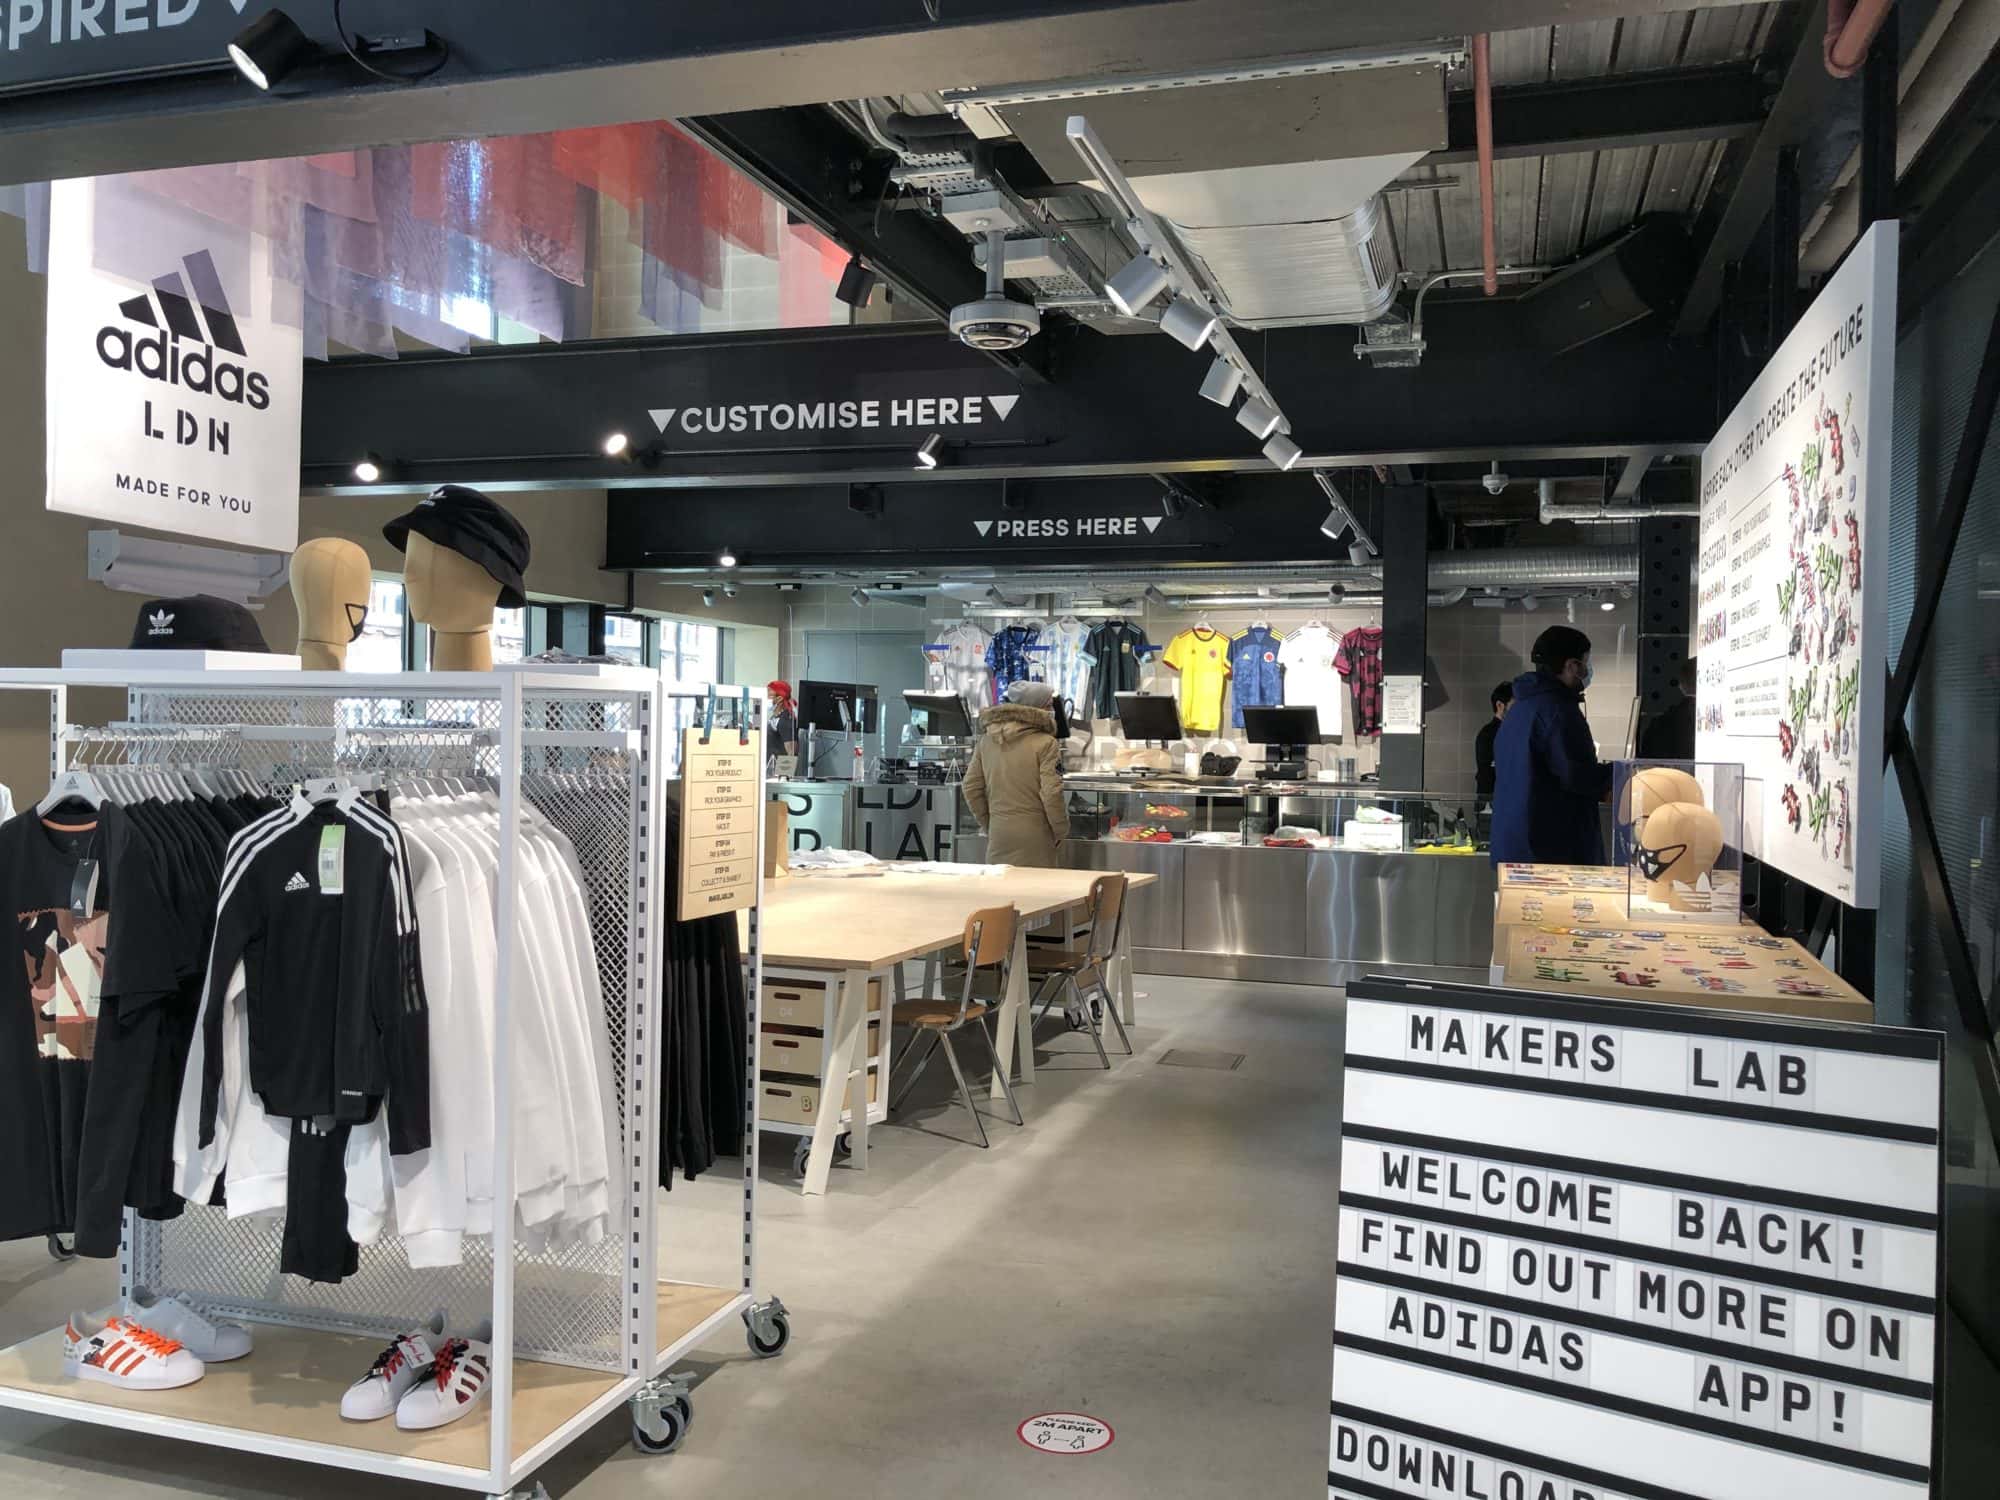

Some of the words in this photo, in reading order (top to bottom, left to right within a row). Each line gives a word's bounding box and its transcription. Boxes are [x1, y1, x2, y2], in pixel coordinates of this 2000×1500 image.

[0, 0, 200, 50] PIRED
[96, 326, 270, 410] adidas
[1734, 430, 1754, 473] OTHER
[1756, 413, 1765, 446] TO
[1767, 381, 1796, 438] CREATE
[1799, 358, 1816, 403] THE
[1819, 304, 1864, 381] FUTURE
[681, 401, 880, 433] CUSTOMISE
[891, 397, 982, 427] HERE
[116, 473, 169, 497] MADE
[177, 486, 210, 506] FOR
[219, 494, 252, 513] YOU
[997, 518, 1069, 537] PRESS
[1076, 517, 1137, 536] HERE
[285, 882, 310, 892] adidas
[1410, 1014, 1615, 1072] MAKERS
[1693, 1047, 1807, 1096] LAB
[1382, 1151, 1613, 1225] WELCOME
[1678, 1198, 1865, 1270] BACK!
[1361, 1218, 1482, 1275] FIND
[1512, 1247, 1611, 1300] OUT
[1639, 1270, 1787, 1339] MORE
[1826, 1307, 1901, 1361] ON
[1388, 1296, 1584, 1372] ADIDAS
[1699, 1364, 1847, 1433] APP!
[1033, 1420, 1056, 1429] 2M
[1057, 1424, 1105, 1435] APART
